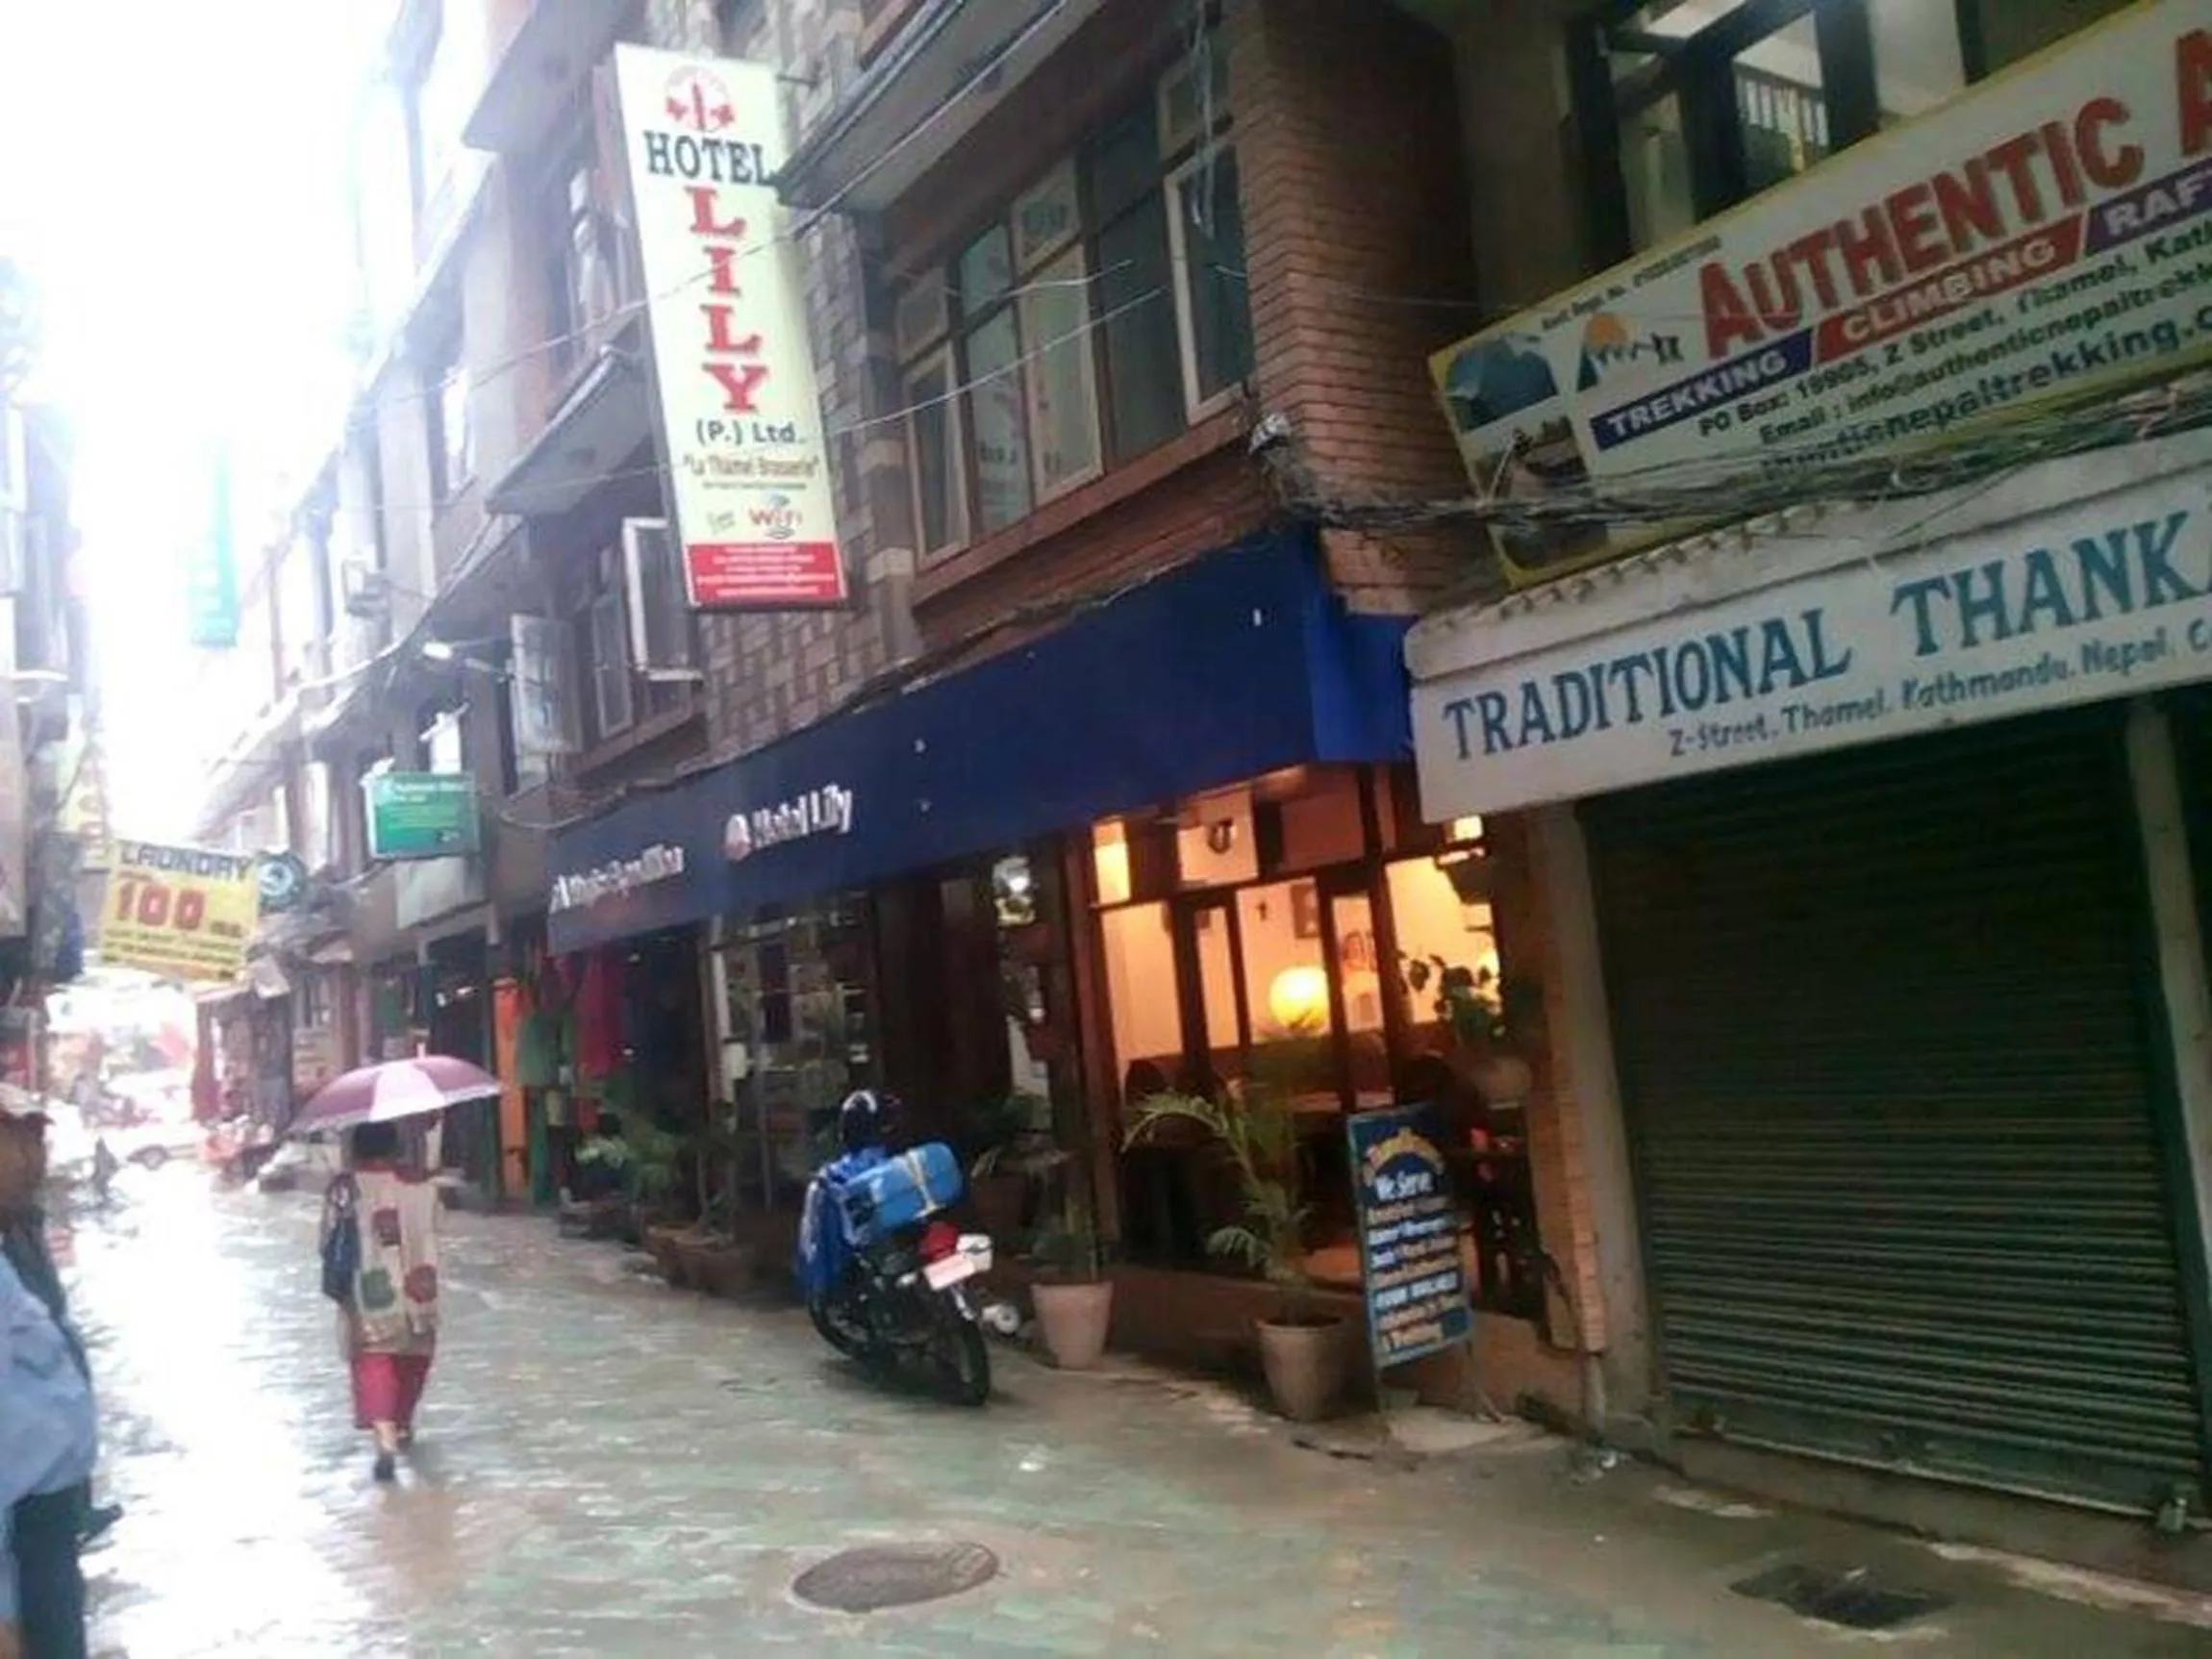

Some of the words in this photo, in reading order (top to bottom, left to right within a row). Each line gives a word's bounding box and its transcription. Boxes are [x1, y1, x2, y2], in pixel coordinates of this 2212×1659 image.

[642, 129, 776, 188] HOTEL
[2103, 165, 2212, 236] RAF
[1698, 96, 2145, 361] AUTHENTIC
[684, 185, 769, 415] LILY
[1841, 239, 2056, 342] CLIMBING
[1603, 349, 1788, 441] TREKKING
[1444, 609, 1853, 764] TRADITIONAL
[1889, 502, 2212, 657] THANK
[116, 879, 205, 931] 100
